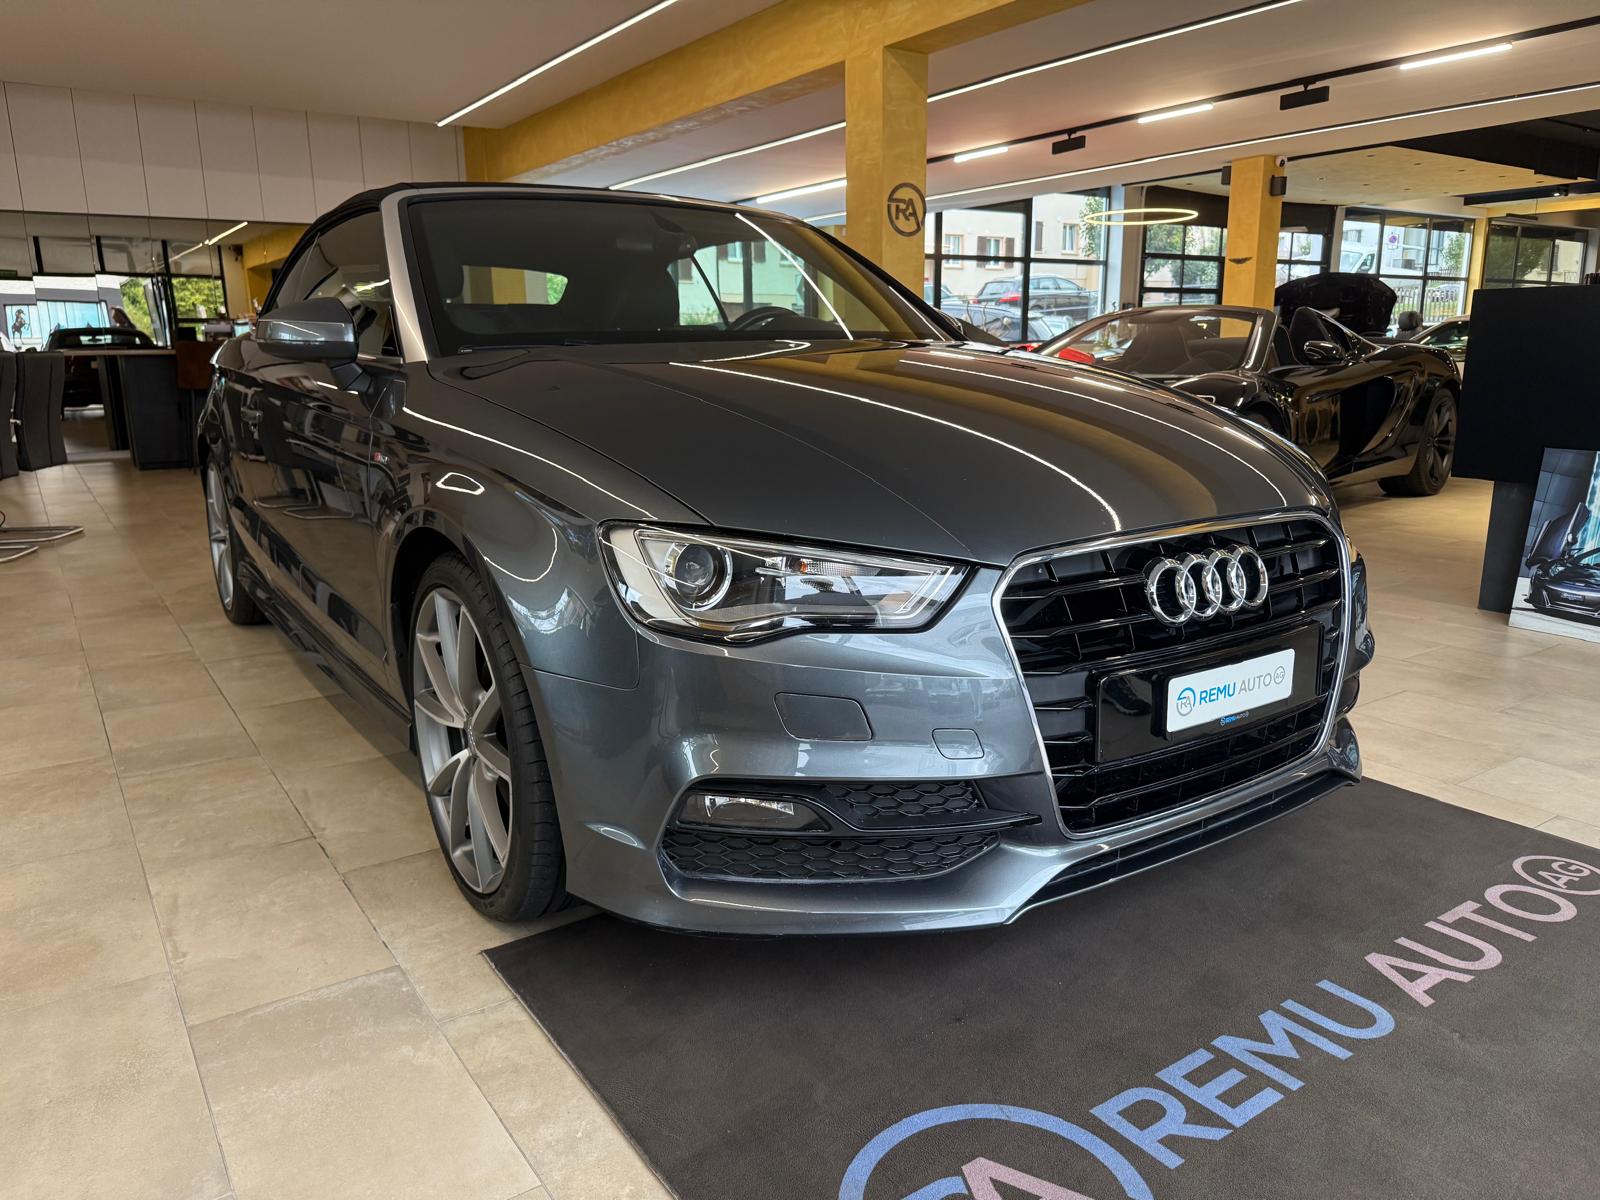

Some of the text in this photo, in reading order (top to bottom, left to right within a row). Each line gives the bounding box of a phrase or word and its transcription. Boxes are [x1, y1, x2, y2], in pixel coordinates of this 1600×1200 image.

[1199, 682, 1236, 705] REMU
[1238, 672, 1272, 694] AUTO
[1088, 860, 1592, 1169] REMU AUTO AG
